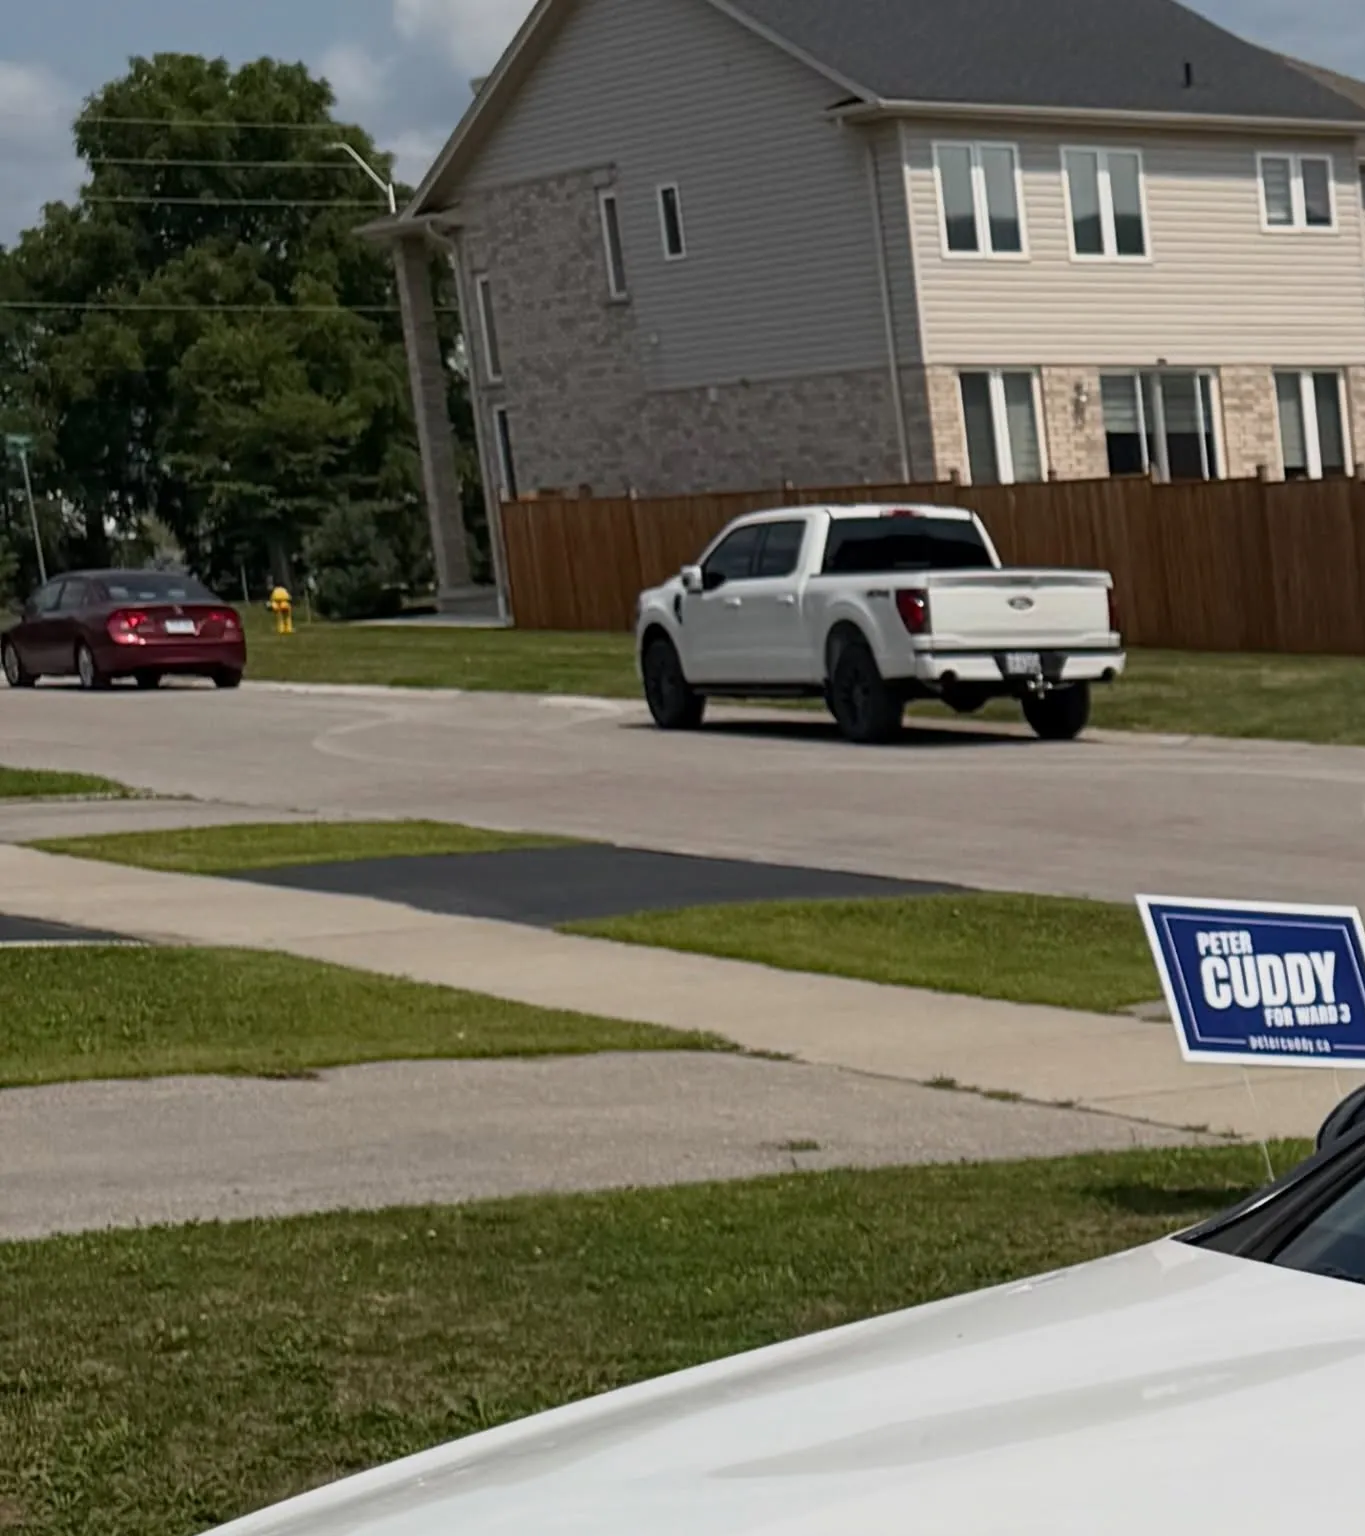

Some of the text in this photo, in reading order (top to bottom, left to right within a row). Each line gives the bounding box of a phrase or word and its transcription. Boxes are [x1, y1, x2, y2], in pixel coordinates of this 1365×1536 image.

[1196, 930, 1253, 955] PETER
[1200, 952, 1336, 1009] CUDDY
[1265, 1003, 1352, 1028] FOR WARD 3
